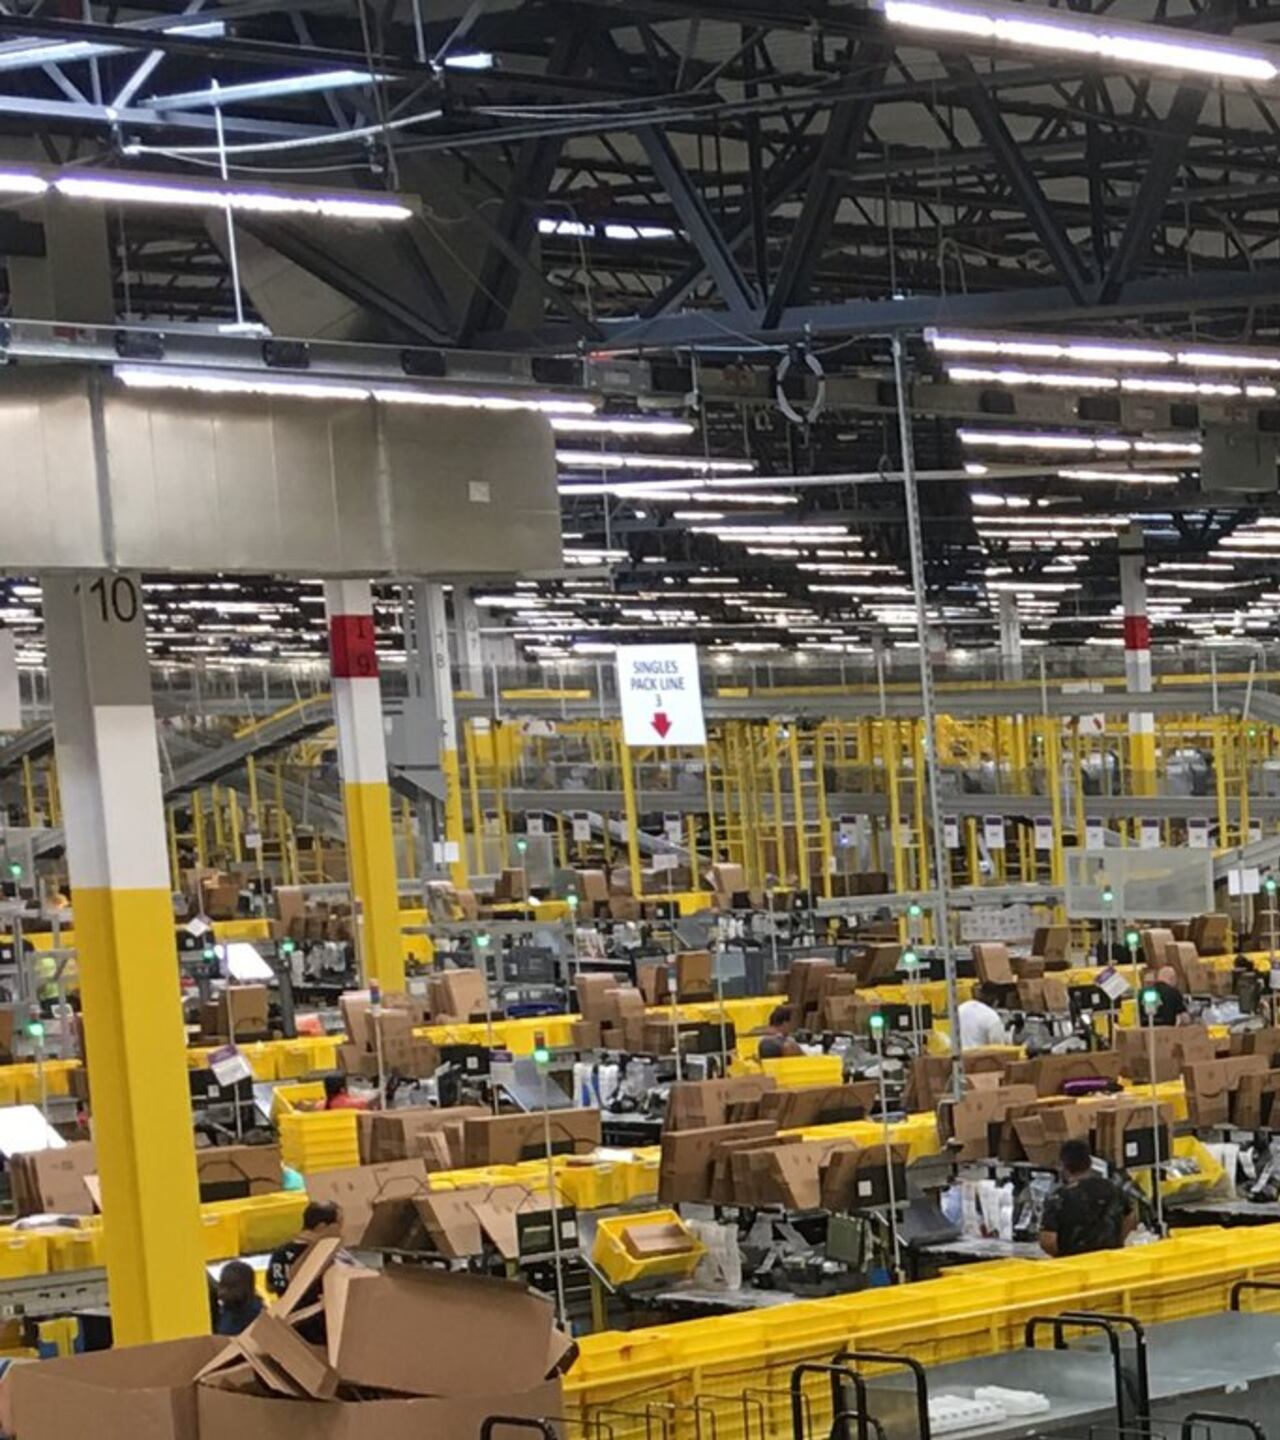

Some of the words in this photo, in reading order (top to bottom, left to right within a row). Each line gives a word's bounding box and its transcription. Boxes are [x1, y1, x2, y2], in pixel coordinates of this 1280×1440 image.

[90, 576, 138, 622] 10
[633, 660, 678, 674] SINGLES
[630, 677, 658, 690] PACK
[660, 676, 685, 690] LINE
